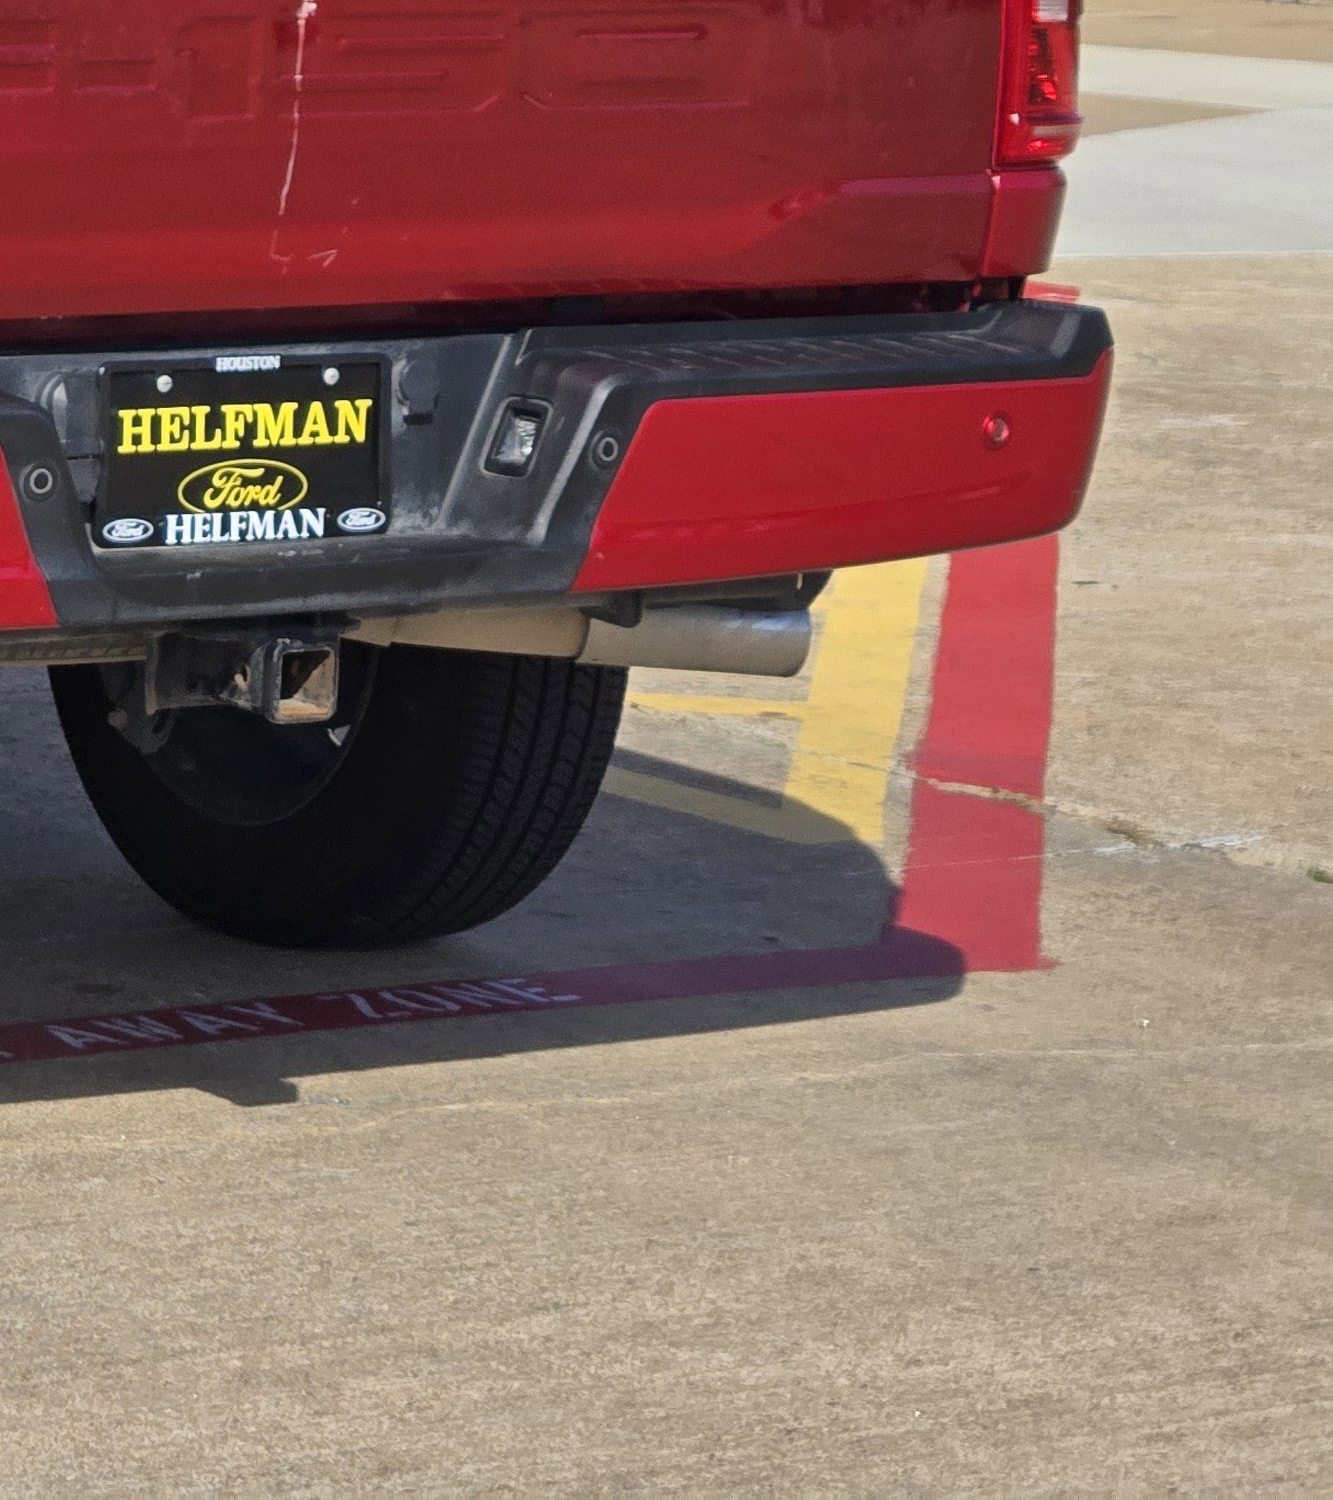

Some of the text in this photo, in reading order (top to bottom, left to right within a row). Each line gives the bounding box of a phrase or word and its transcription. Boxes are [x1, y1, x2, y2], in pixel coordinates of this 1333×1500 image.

[215, 355, 281, 372] HOUSTON
[116, 399, 373, 454] HELFMAN
[203, 467, 284, 511] Ford
[164, 508, 326, 546] HELFMAN
[45, 1003, 306, 1050] AWAY
[315, 977, 583, 1019] ZONE
